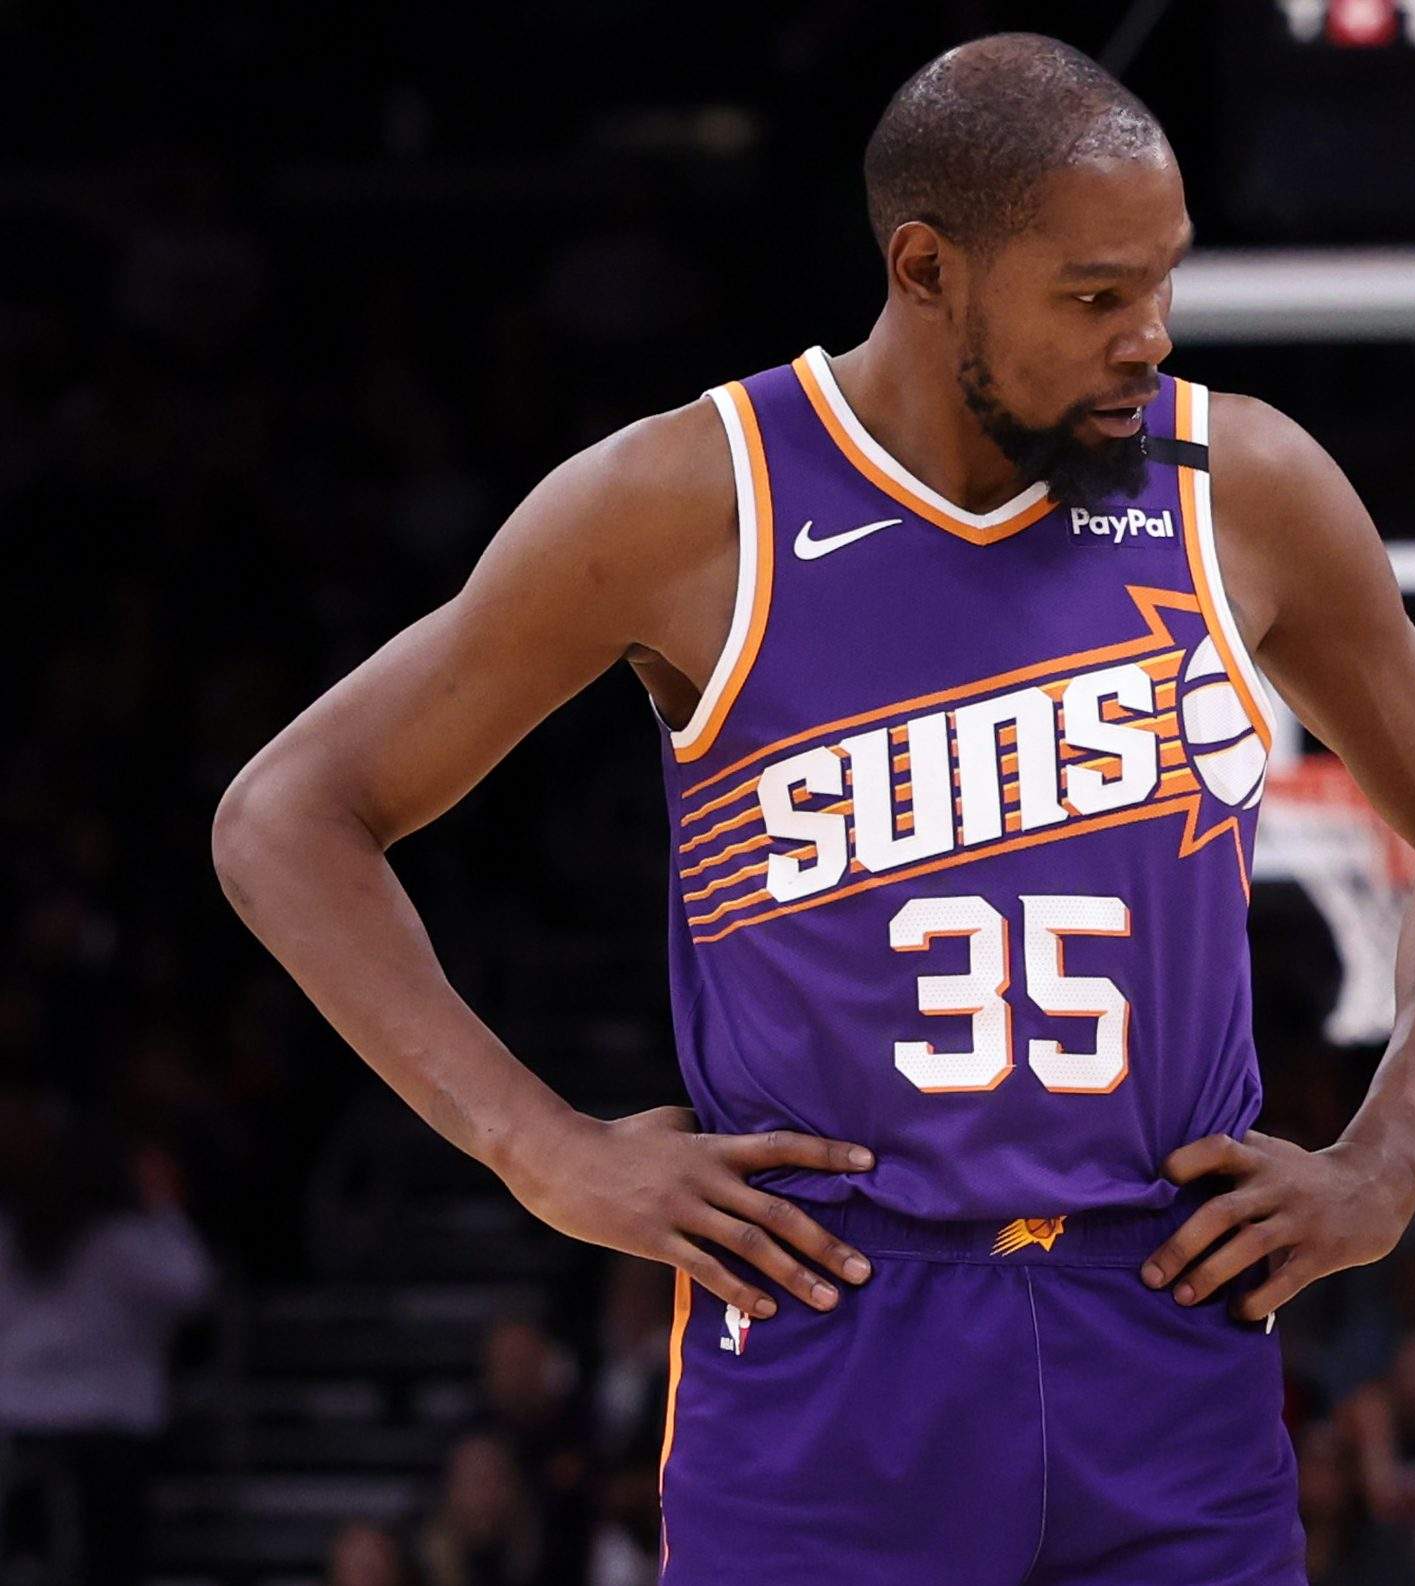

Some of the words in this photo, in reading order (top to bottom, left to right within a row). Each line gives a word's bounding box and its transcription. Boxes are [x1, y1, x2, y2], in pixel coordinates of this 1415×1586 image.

[1070, 507, 1174, 543] PayPal
[757, 663, 1160, 903] SUNS
[889, 895, 1131, 1094] 35
